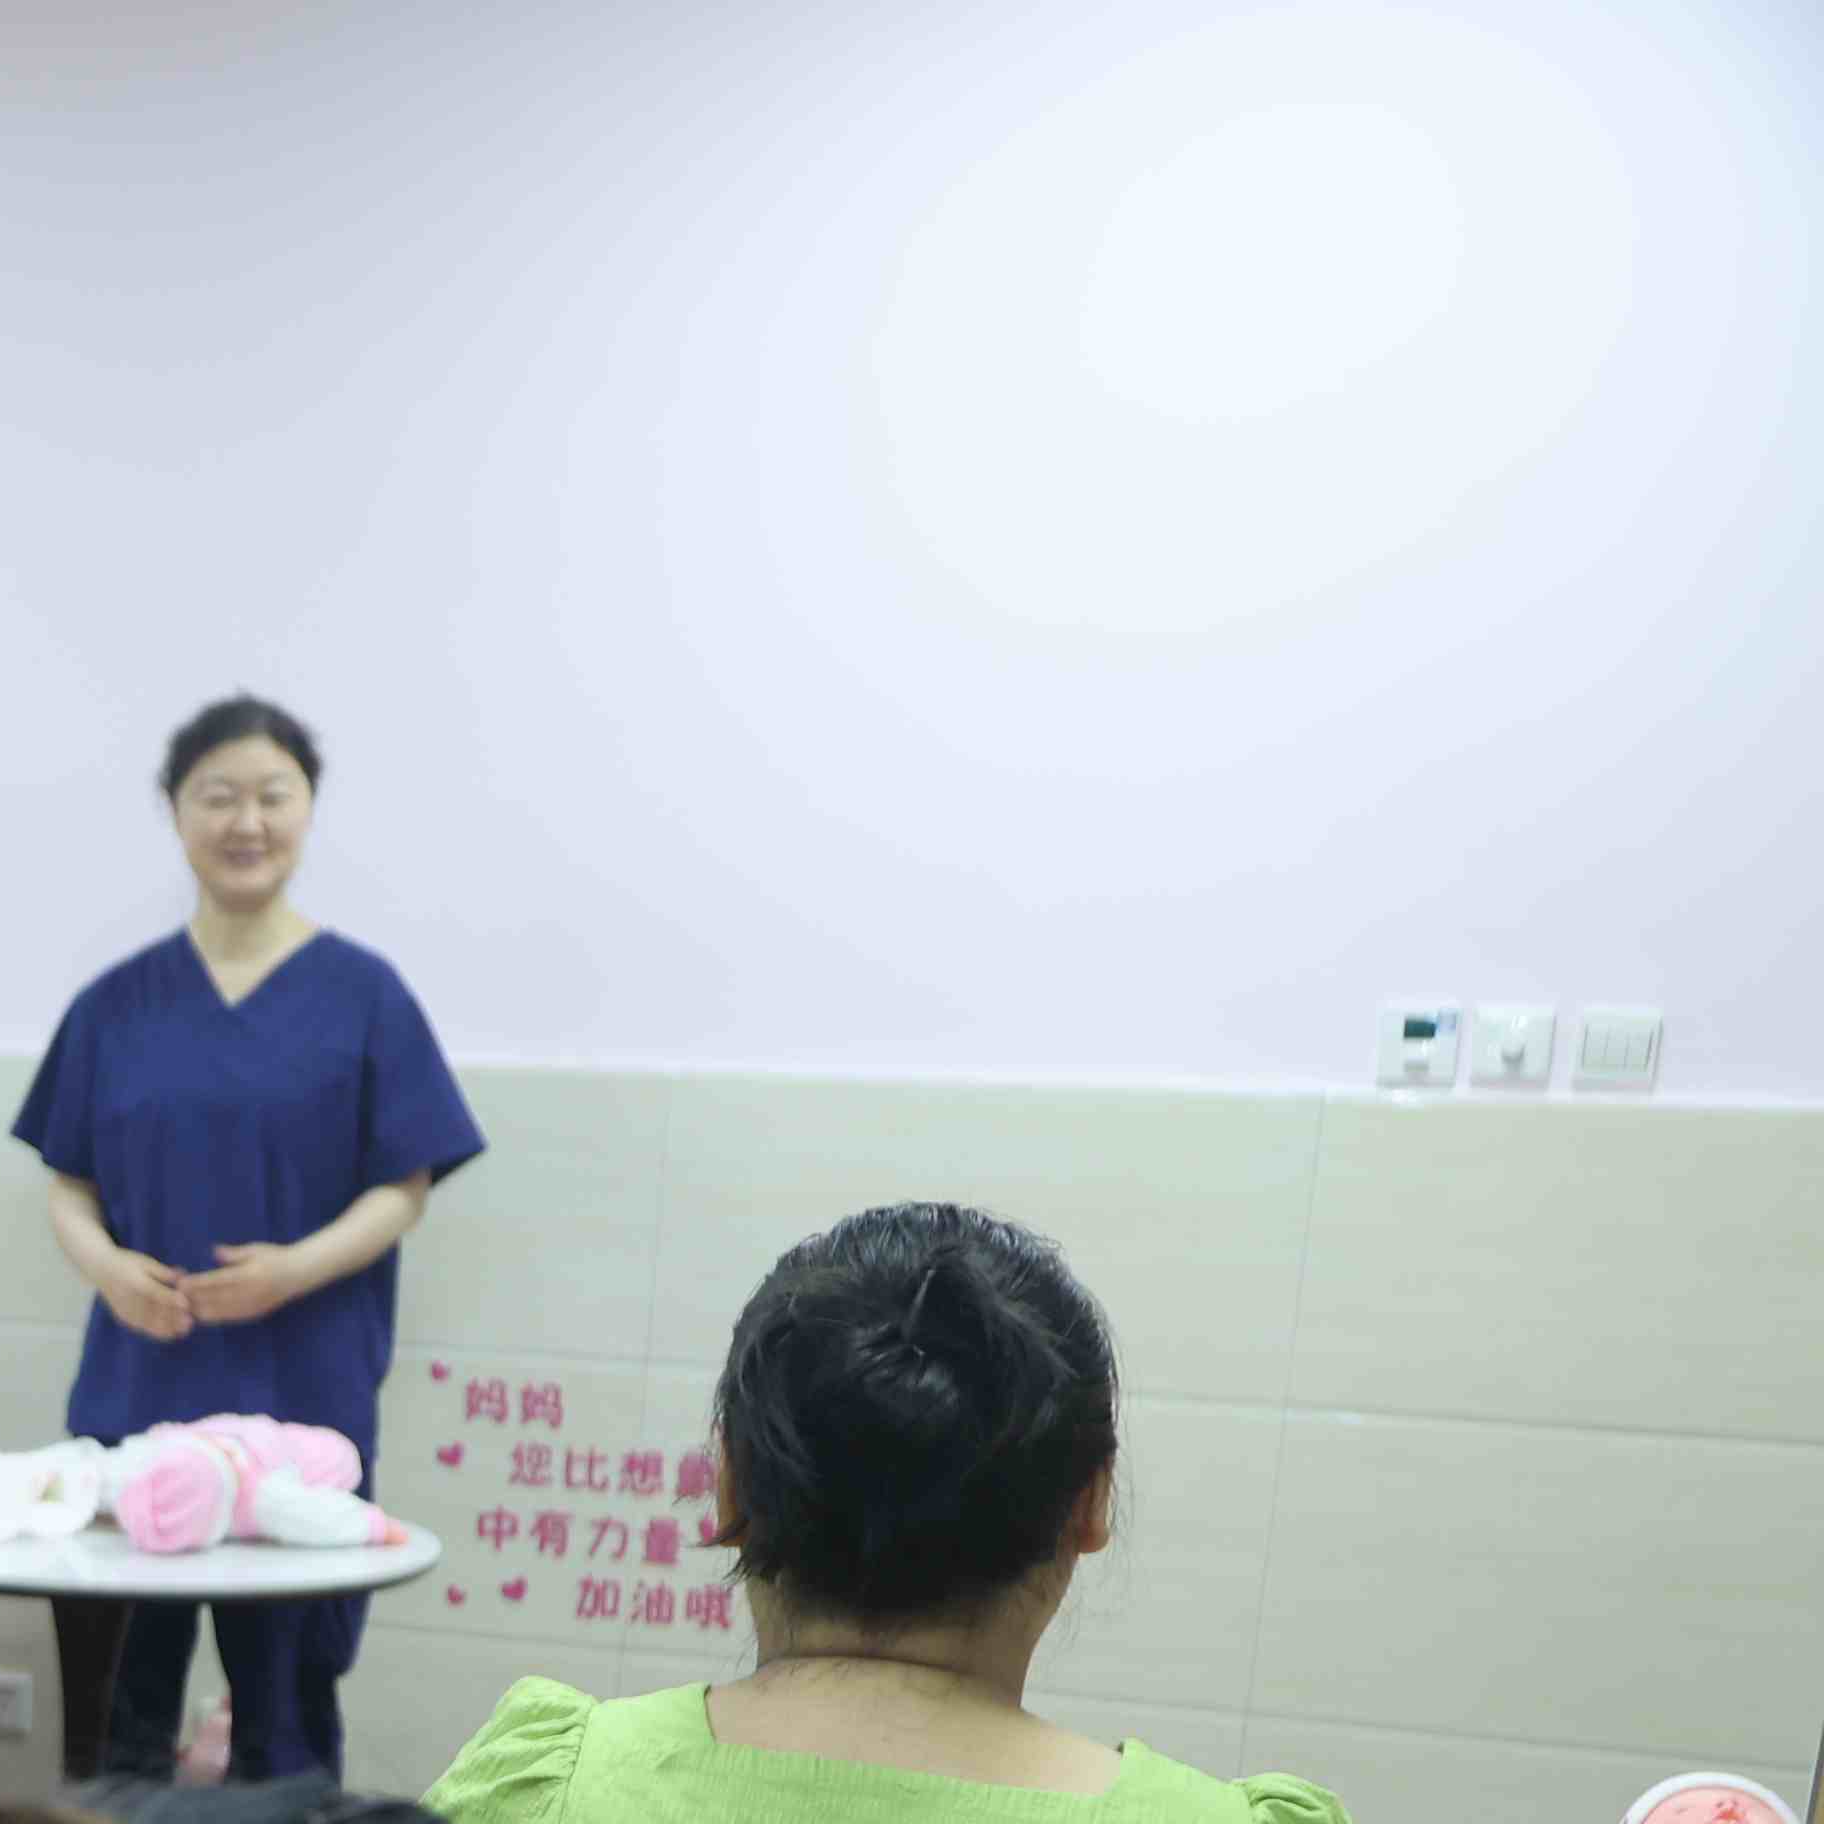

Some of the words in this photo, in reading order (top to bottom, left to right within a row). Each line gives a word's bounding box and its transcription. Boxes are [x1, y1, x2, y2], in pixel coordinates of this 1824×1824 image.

[465, 1377, 563, 1429] 妈妈
[476, 1505, 681, 1566] 中有力量
[575, 1575, 732, 1630] 加油哦
